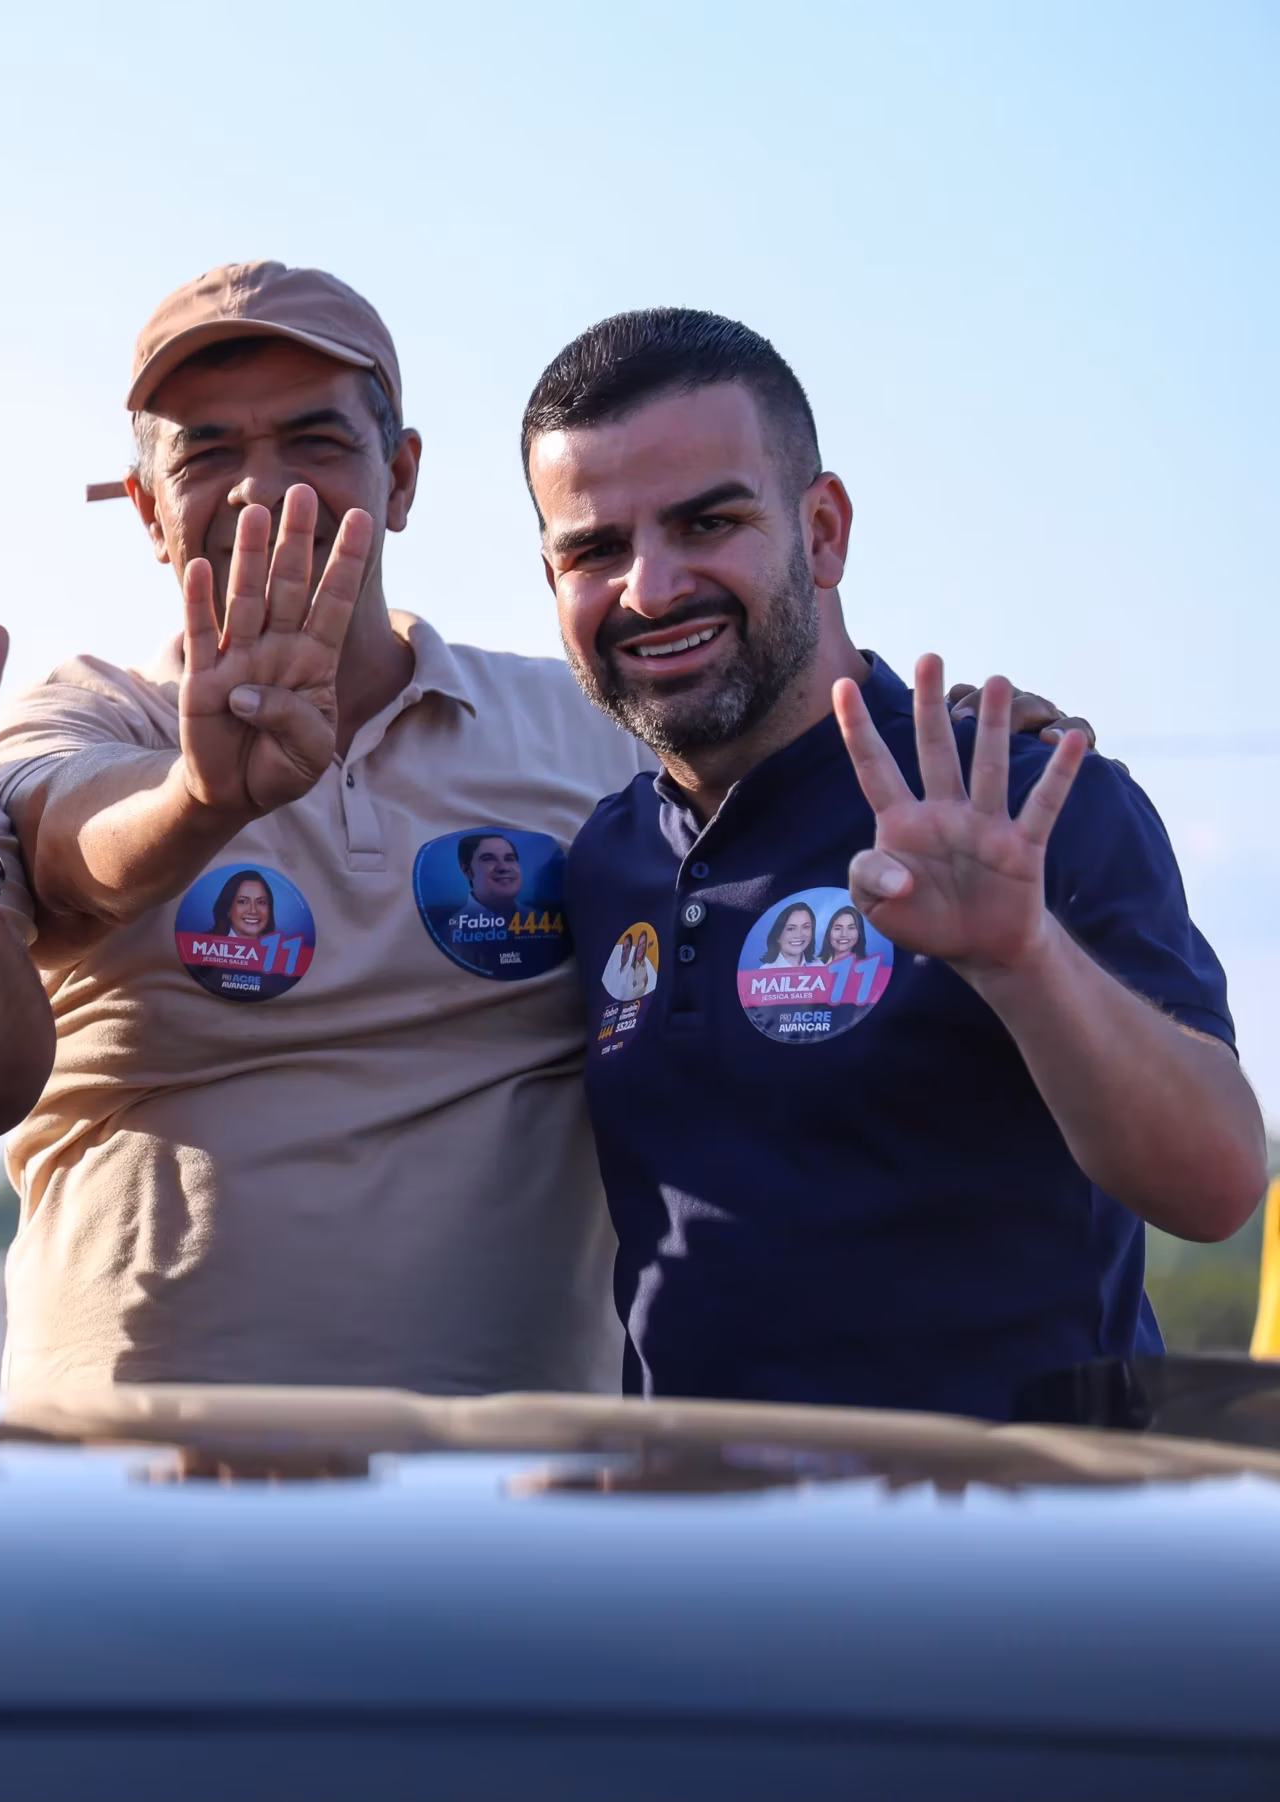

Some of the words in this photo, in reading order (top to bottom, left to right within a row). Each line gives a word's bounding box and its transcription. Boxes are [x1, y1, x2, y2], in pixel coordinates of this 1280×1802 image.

[459, 913, 505, 929] Fabio
[508, 910, 563, 935] 4444
[452, 928, 508, 943] Rueda
[192, 941, 259, 961] MAILZA
[261, 932, 302, 975] 11
[229, 958, 249, 966] SALES
[232, 974, 261, 985] ACRE
[751, 975, 826, 995] MAILZA
[828, 955, 881, 1004] 11
[790, 992, 813, 1000] SALES
[779, 1013, 792, 1023] PRO
[792, 1011, 832, 1023] ACRE
[778, 1022, 831, 1033] AVANÇAR
